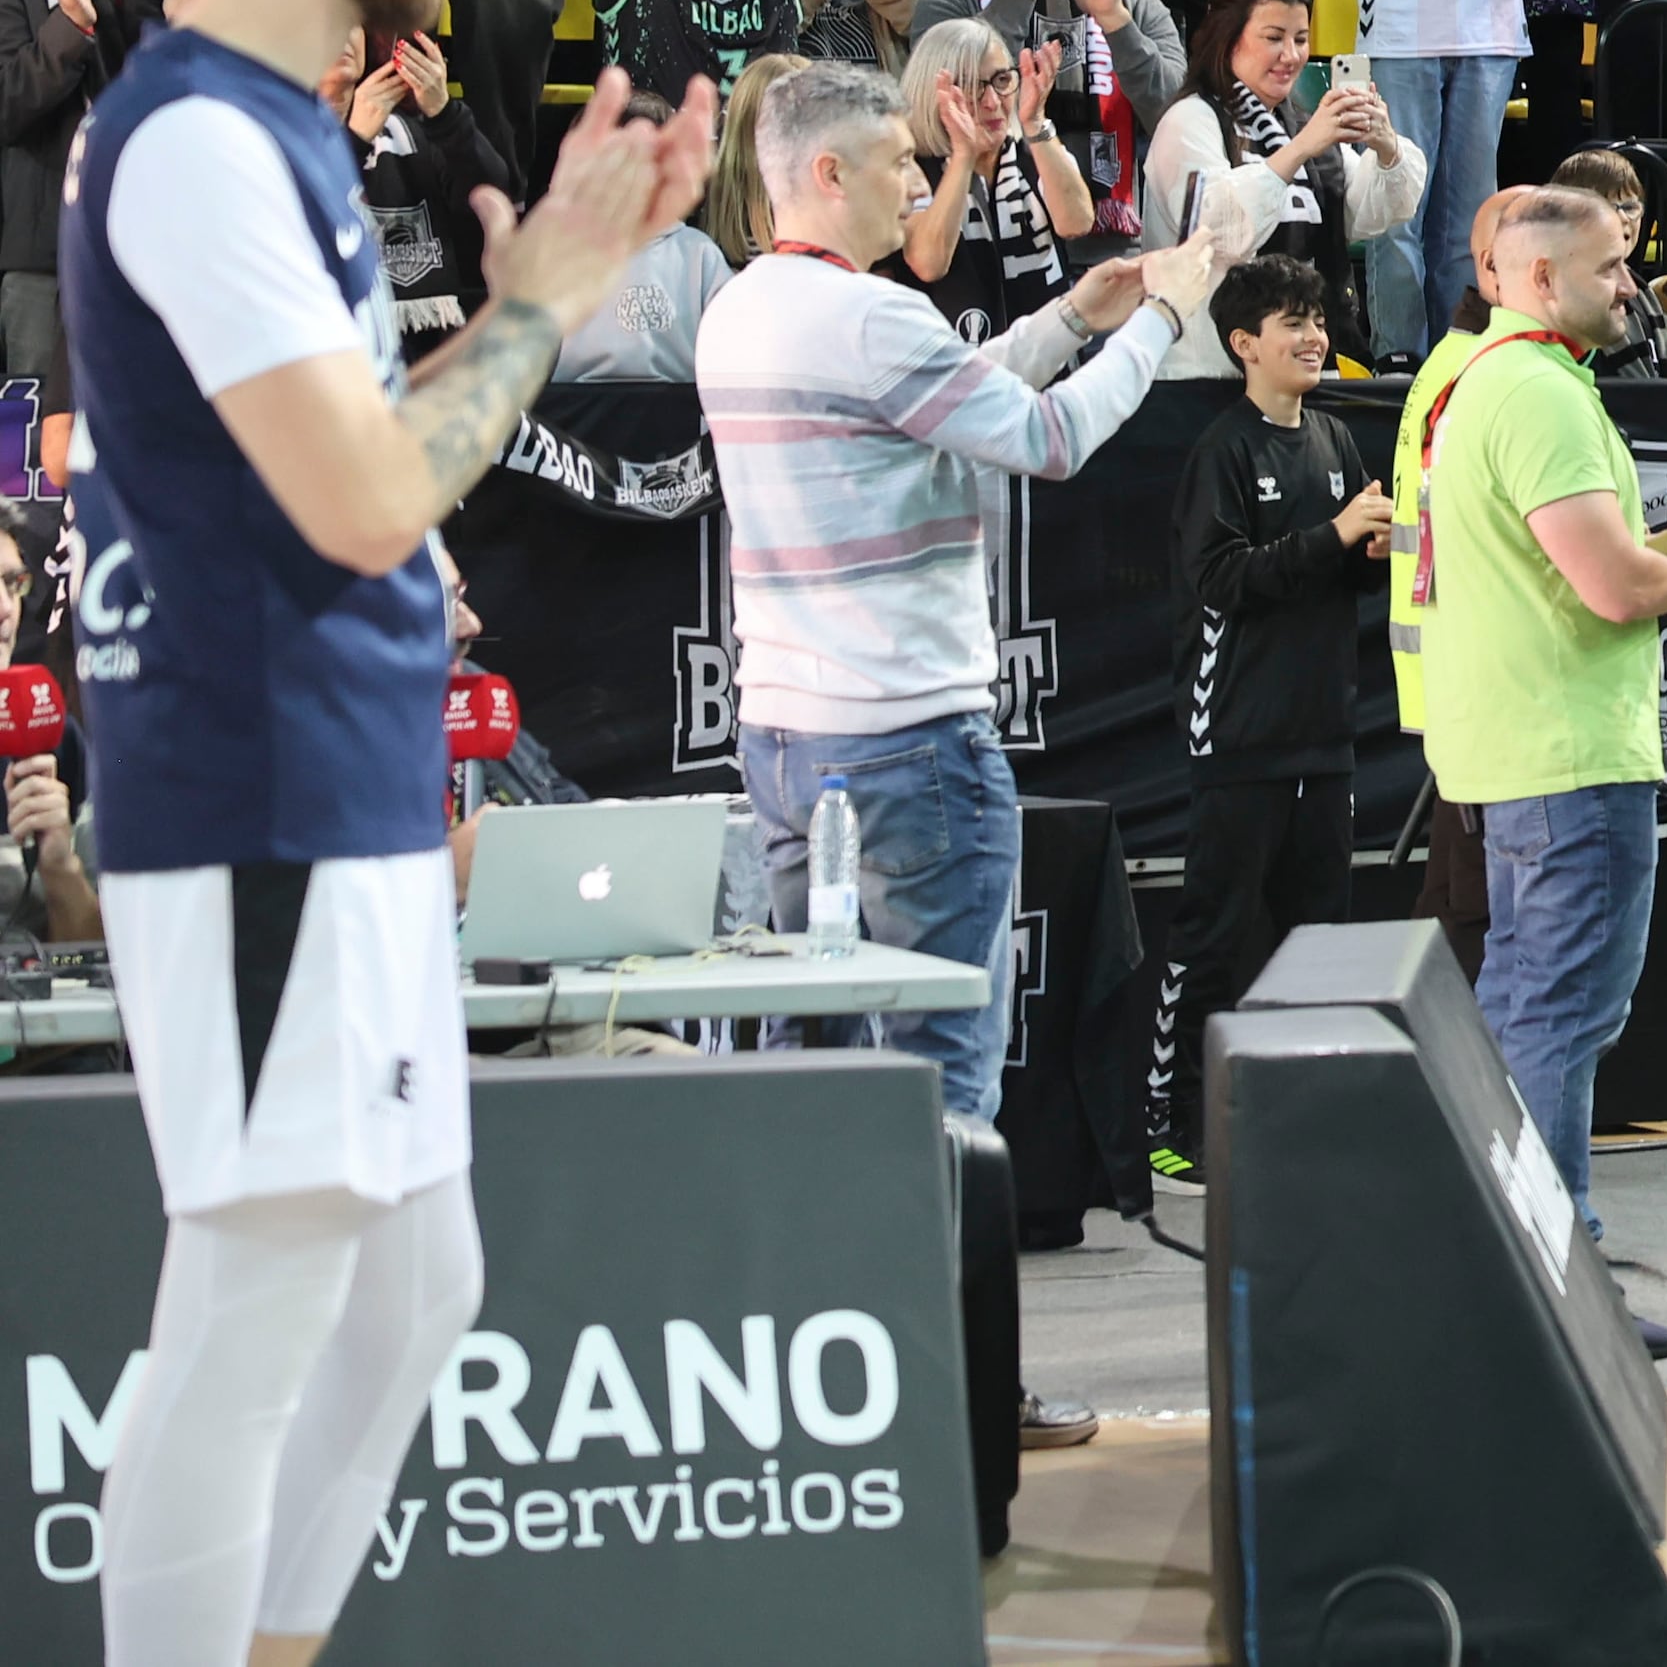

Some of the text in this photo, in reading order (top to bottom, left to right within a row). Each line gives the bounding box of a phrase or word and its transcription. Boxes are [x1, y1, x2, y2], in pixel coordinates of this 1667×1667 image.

[616, 470, 713, 509] BILBAOBASKET
[27, 1310, 899, 1494] MRANO
[446, 1458, 903, 1559] Servicios
